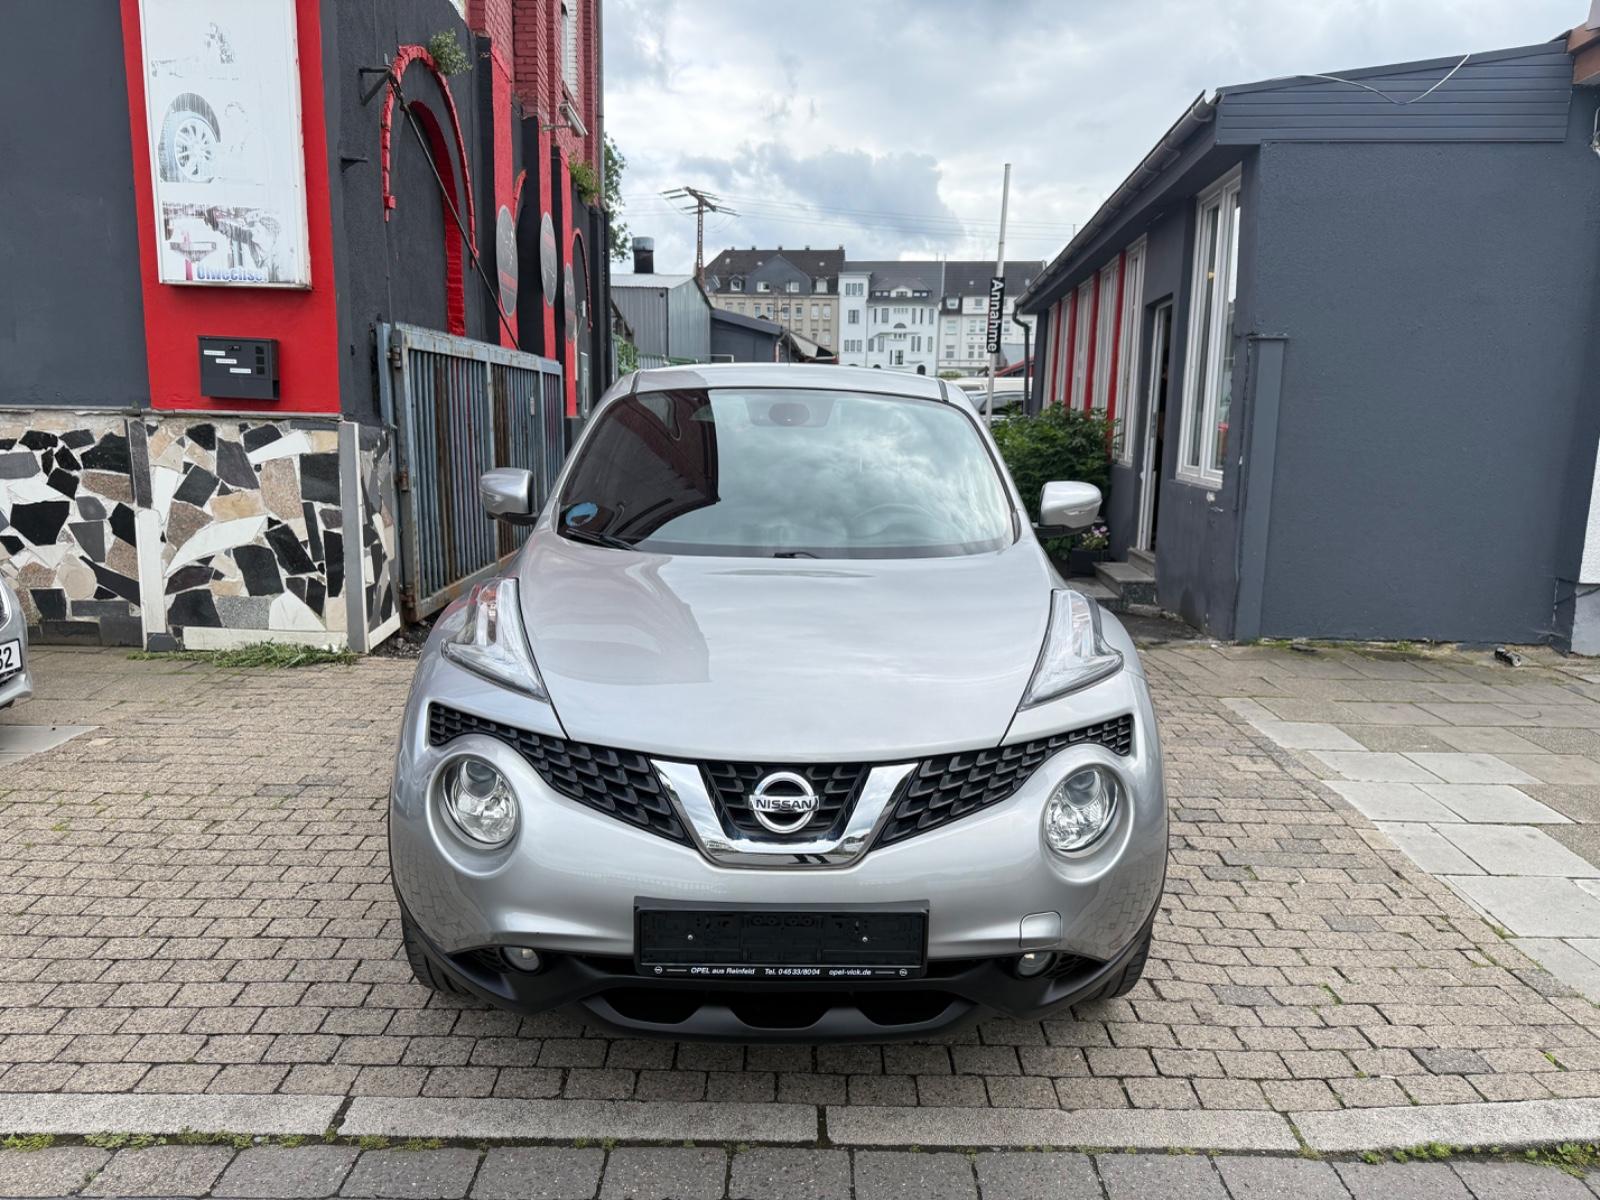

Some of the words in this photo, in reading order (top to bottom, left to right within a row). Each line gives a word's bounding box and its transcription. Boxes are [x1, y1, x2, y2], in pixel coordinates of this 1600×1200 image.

[987, 280, 1004, 352] Annahme
[755, 799, 812, 809] NISSAN
[726, 967, 756, 975] Reinfeld
